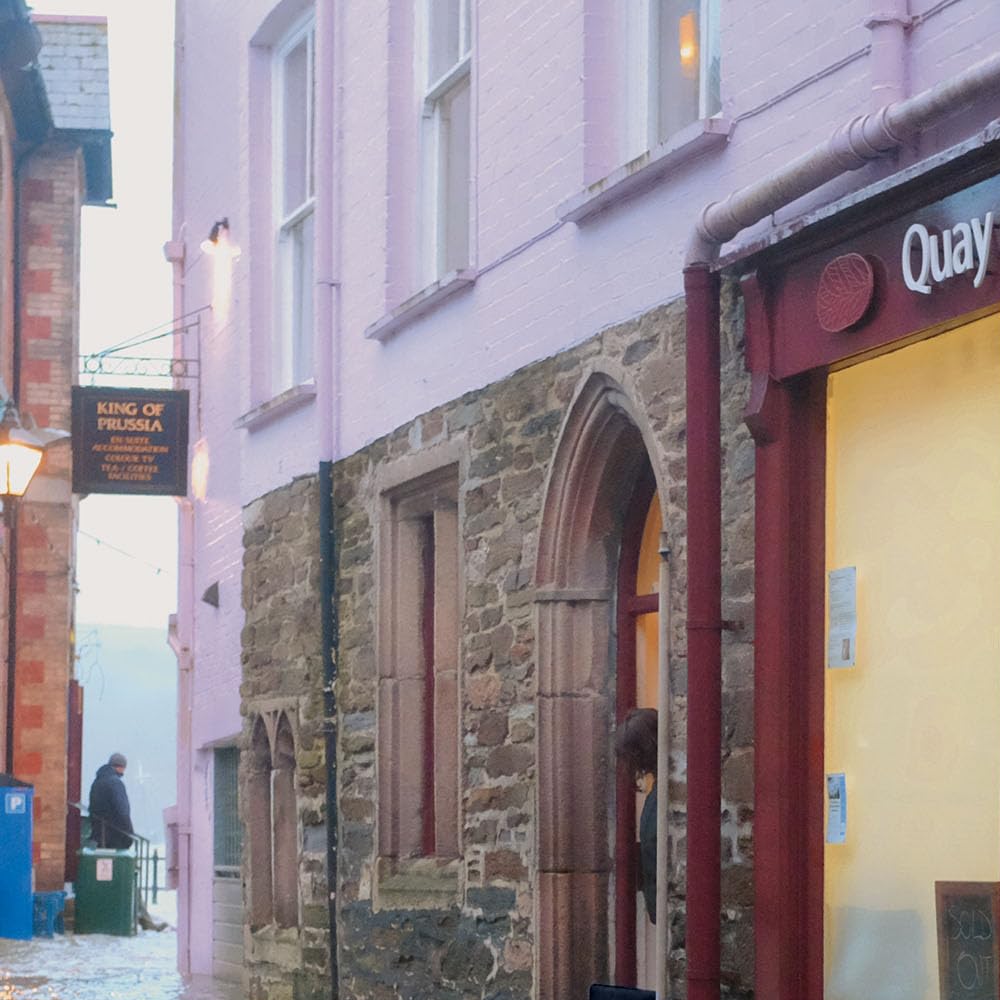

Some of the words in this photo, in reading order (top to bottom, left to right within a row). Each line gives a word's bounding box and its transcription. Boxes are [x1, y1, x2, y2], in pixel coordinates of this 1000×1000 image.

[902, 211, 994, 294] Quay
[97, 402, 137, 416] KING
[142, 403, 165, 416] OF
[97, 418, 163, 432] PRUSSIA
[10, 796, 22, 811] P
[948, 907, 993, 940] SOLD
